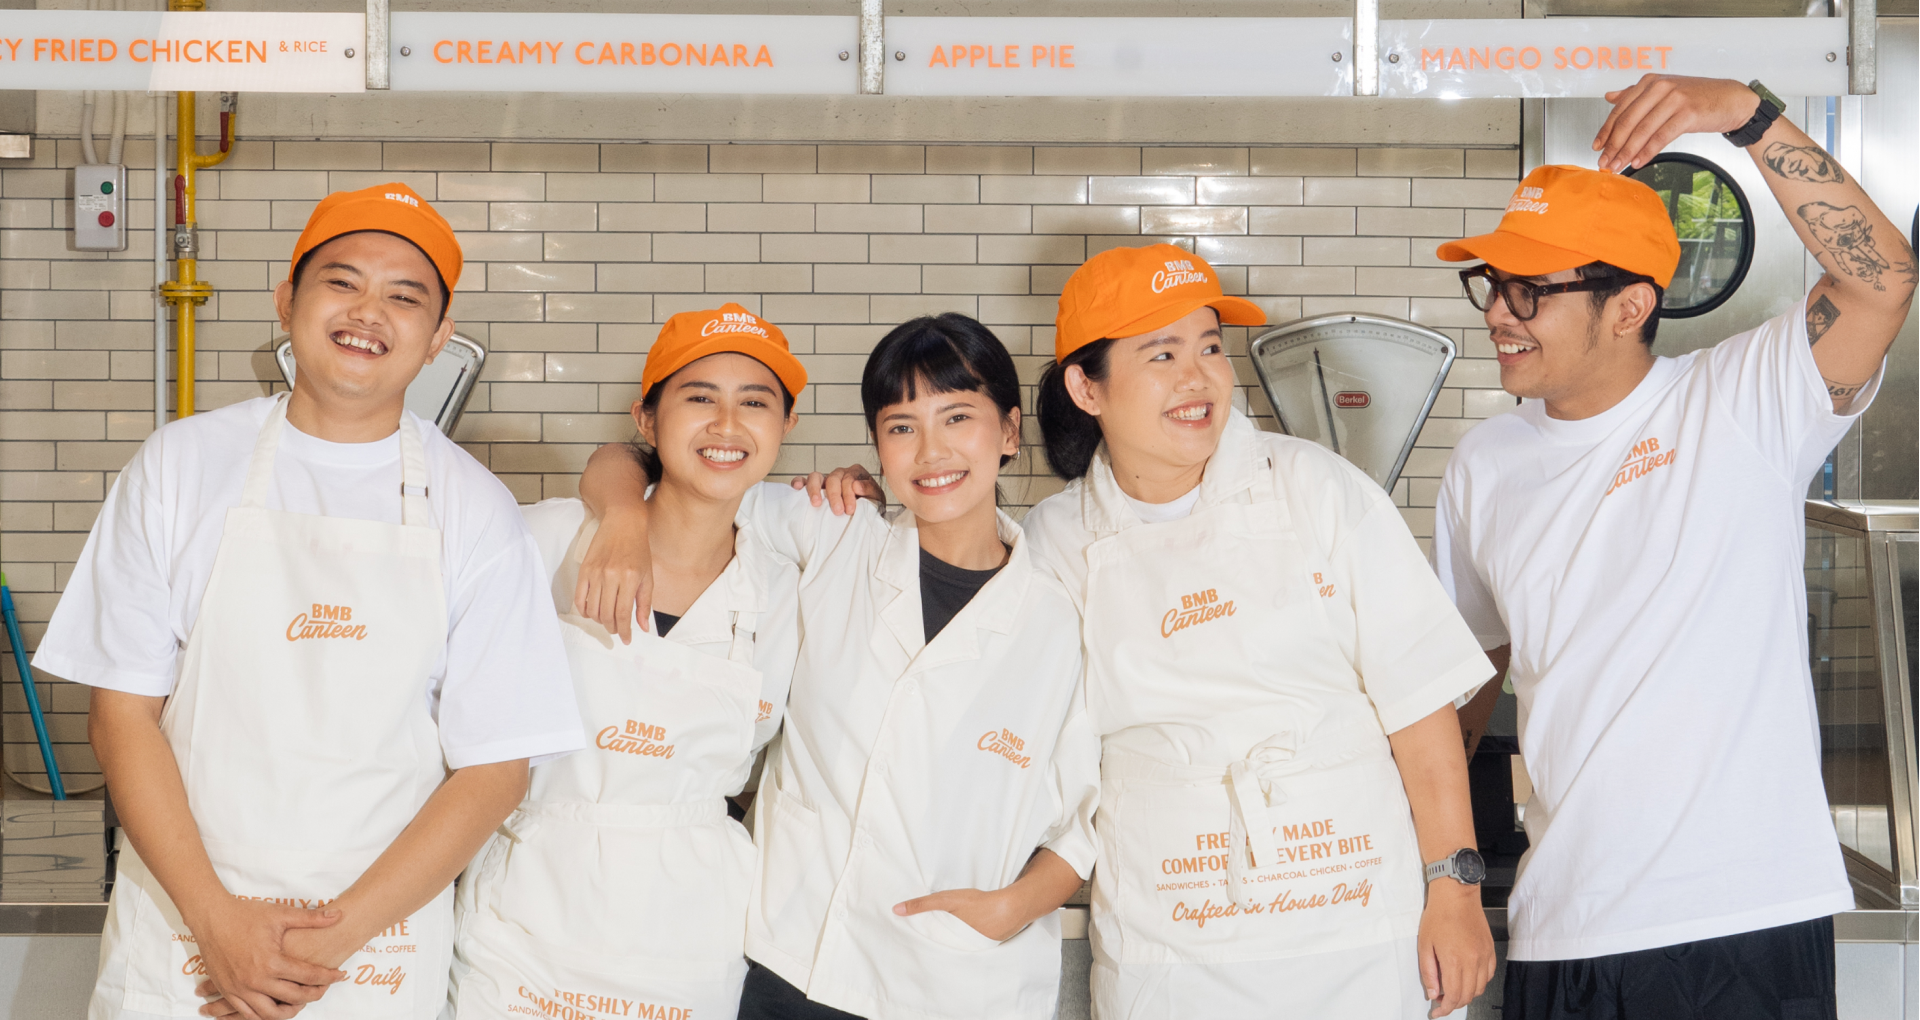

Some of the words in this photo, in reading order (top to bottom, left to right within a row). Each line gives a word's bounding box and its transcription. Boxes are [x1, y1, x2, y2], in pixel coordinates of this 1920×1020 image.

[34, 38, 117, 62] FRIED
[128, 39, 267, 63] CHICKEN
[279, 40, 289, 52] &
[294, 40, 328, 53] RICE
[433, 40, 564, 64] CREAMY
[575, 41, 774, 67] CARBONARA
[928, 45, 1020, 68] APPLE
[1032, 45, 1075, 68] PIE
[1421, 46, 1542, 70] MANGO
[1554, 46, 1673, 70] SORBET
[1164, 259, 1194, 272] BMB
[1151, 270, 1208, 294] Canteen
[701, 319, 769, 339] Canteen
[722, 312, 757, 325] BMB
[1339, 395, 1365, 404] Berkel
[1606, 448, 1676, 496] anteen
[1181, 588, 1219, 610] BMB
[312, 603, 352, 621] BMB
[1161, 600, 1237, 639] Canteen
[286, 612, 368, 642] Canteen
[758, 699, 773, 715] MB
[625, 719, 666, 742] BMB
[1001, 728, 1025, 751] BMB
[596, 725, 675, 760] Canteen
[977, 731, 1031, 769] Canteen
[1283, 818, 1336, 842] MADE
[1337, 834, 1374, 856] BITE
[1156, 880, 1210, 892] SANDWICHES
[1257, 870, 1307, 883] CHARCOAL
[1309, 863, 1347, 877] CHICKEN
[1354, 856, 1382, 869] COFFEE
[1172, 898, 1239, 928] Crafted
[1268, 889, 1328, 914] House
[1331, 878, 1373, 907] Daily
[385, 944, 417, 954] COFFEE
[354, 963, 407, 996] Daily
[637, 1002, 693, 1020] MADE
